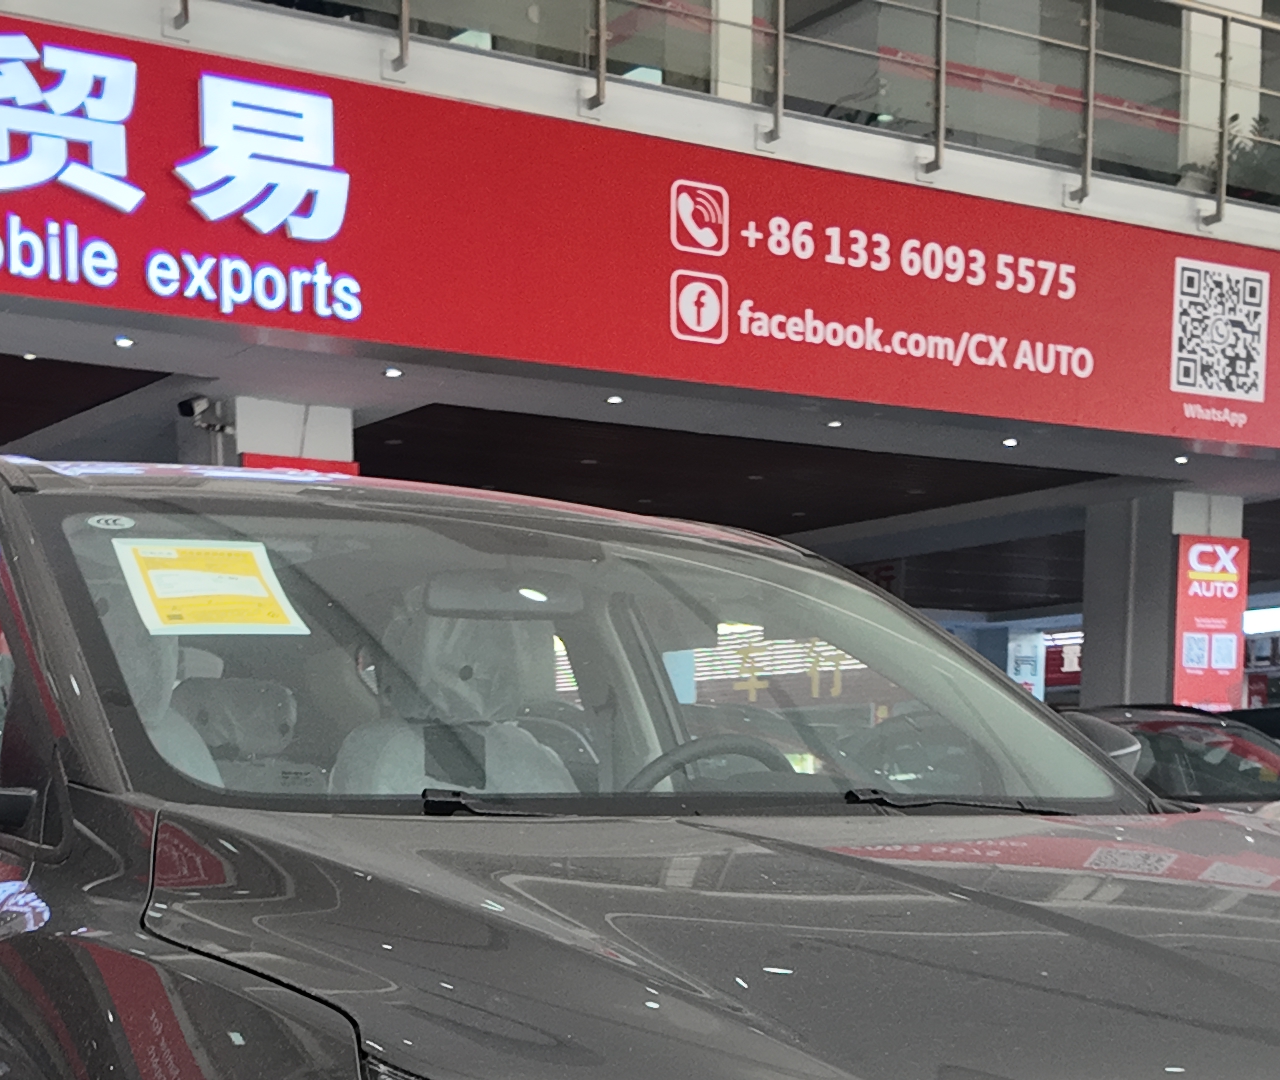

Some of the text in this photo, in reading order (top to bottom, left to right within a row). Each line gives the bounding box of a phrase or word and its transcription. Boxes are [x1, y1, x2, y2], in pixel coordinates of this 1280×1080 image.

[741, 216, 1077, 300] +86 133 6093 5575
[147, 250, 363, 321] exports
[737, 300, 1095, 379] facebook.com/CX AUTO
[1183, 403, 1248, 428] WhatsApp
[1188, 543, 1239, 574] CX
[1188, 580, 1239, 598] AUTO
